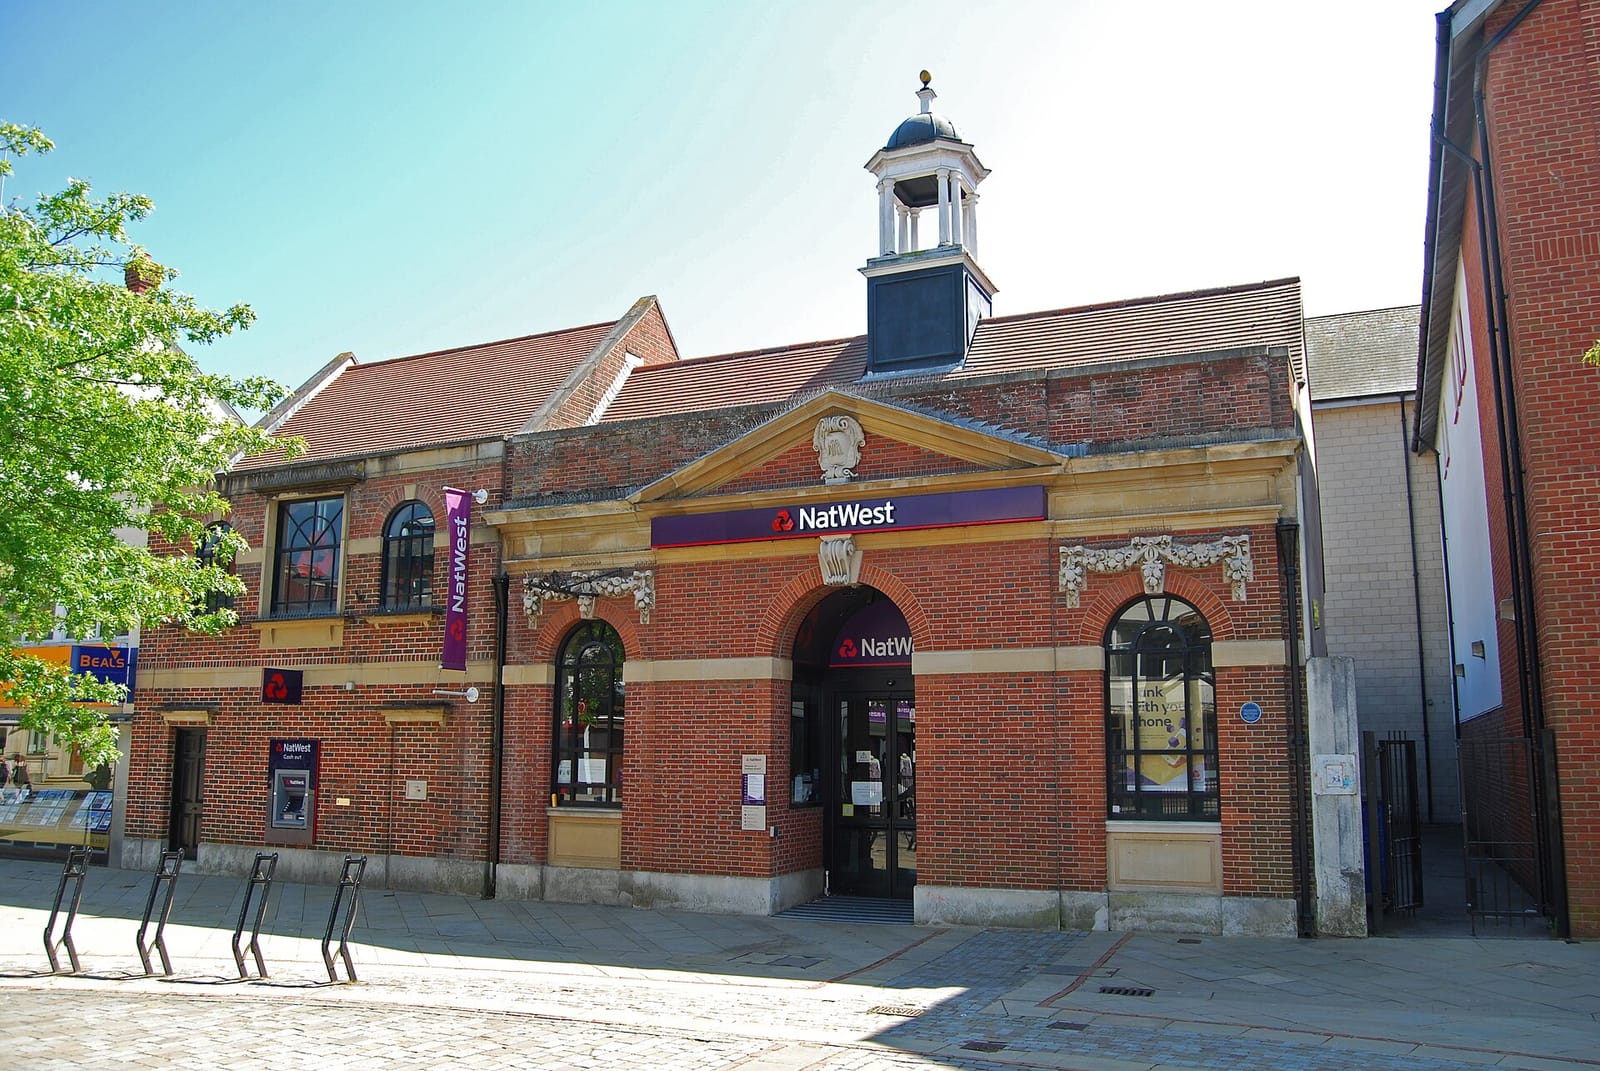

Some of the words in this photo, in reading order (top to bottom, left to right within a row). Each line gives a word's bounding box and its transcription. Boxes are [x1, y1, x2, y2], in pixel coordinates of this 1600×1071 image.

[799, 501, 895, 530] NatWest
[451, 516, 468, 613] NatWest
[861, 637, 915, 658] NatW
[1136, 685, 1164, 697] nk
[283, 743, 311, 752] NatWest
